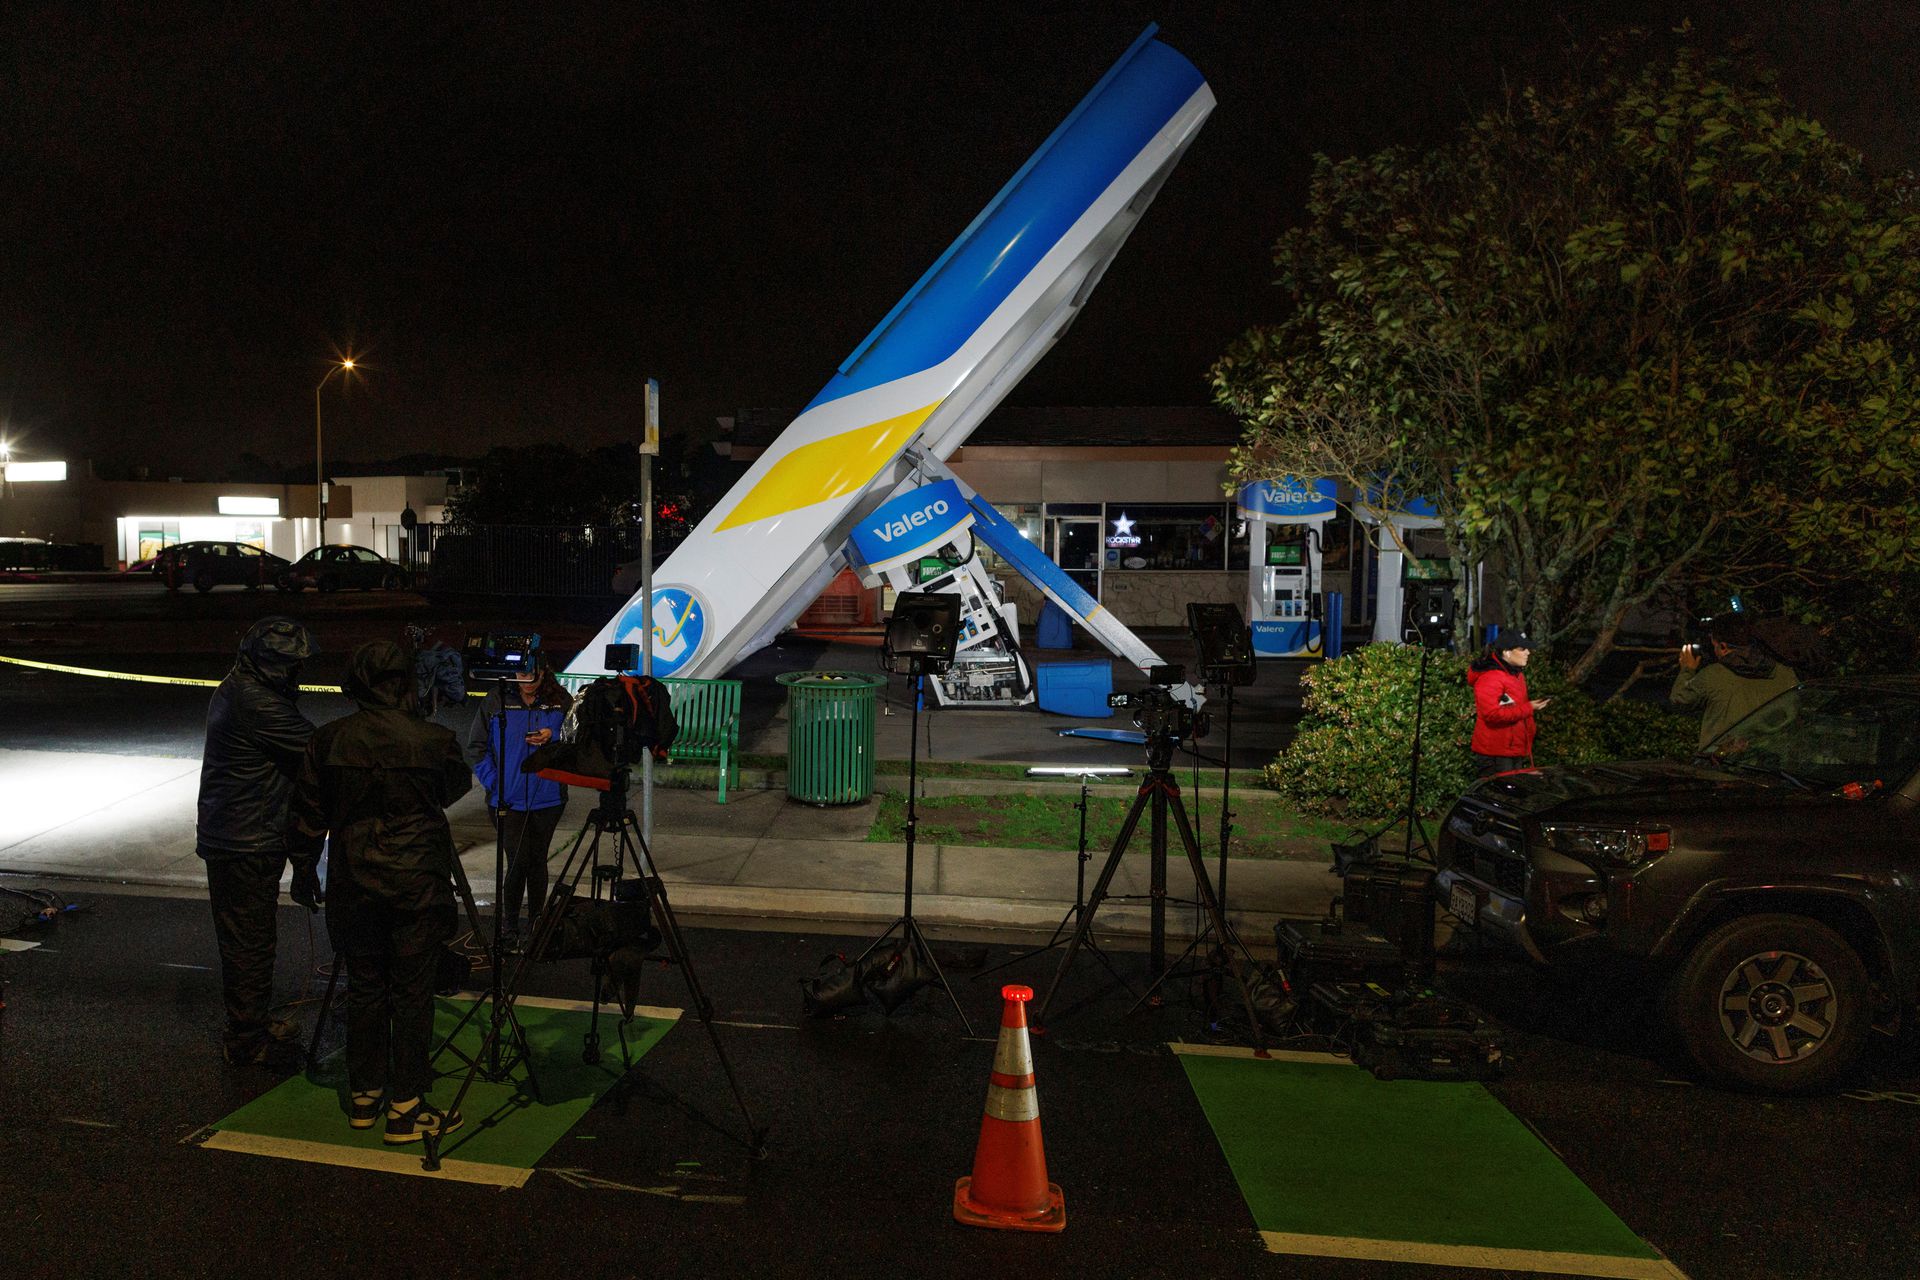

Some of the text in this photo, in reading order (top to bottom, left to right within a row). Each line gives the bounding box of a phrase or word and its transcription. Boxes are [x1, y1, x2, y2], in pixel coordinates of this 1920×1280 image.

[1262, 488, 1323, 504] Valero
[872, 499, 949, 543] Valero
[1105, 536, 1142, 545] ROCKSTAR
[1255, 625, 1285, 633] Valero
